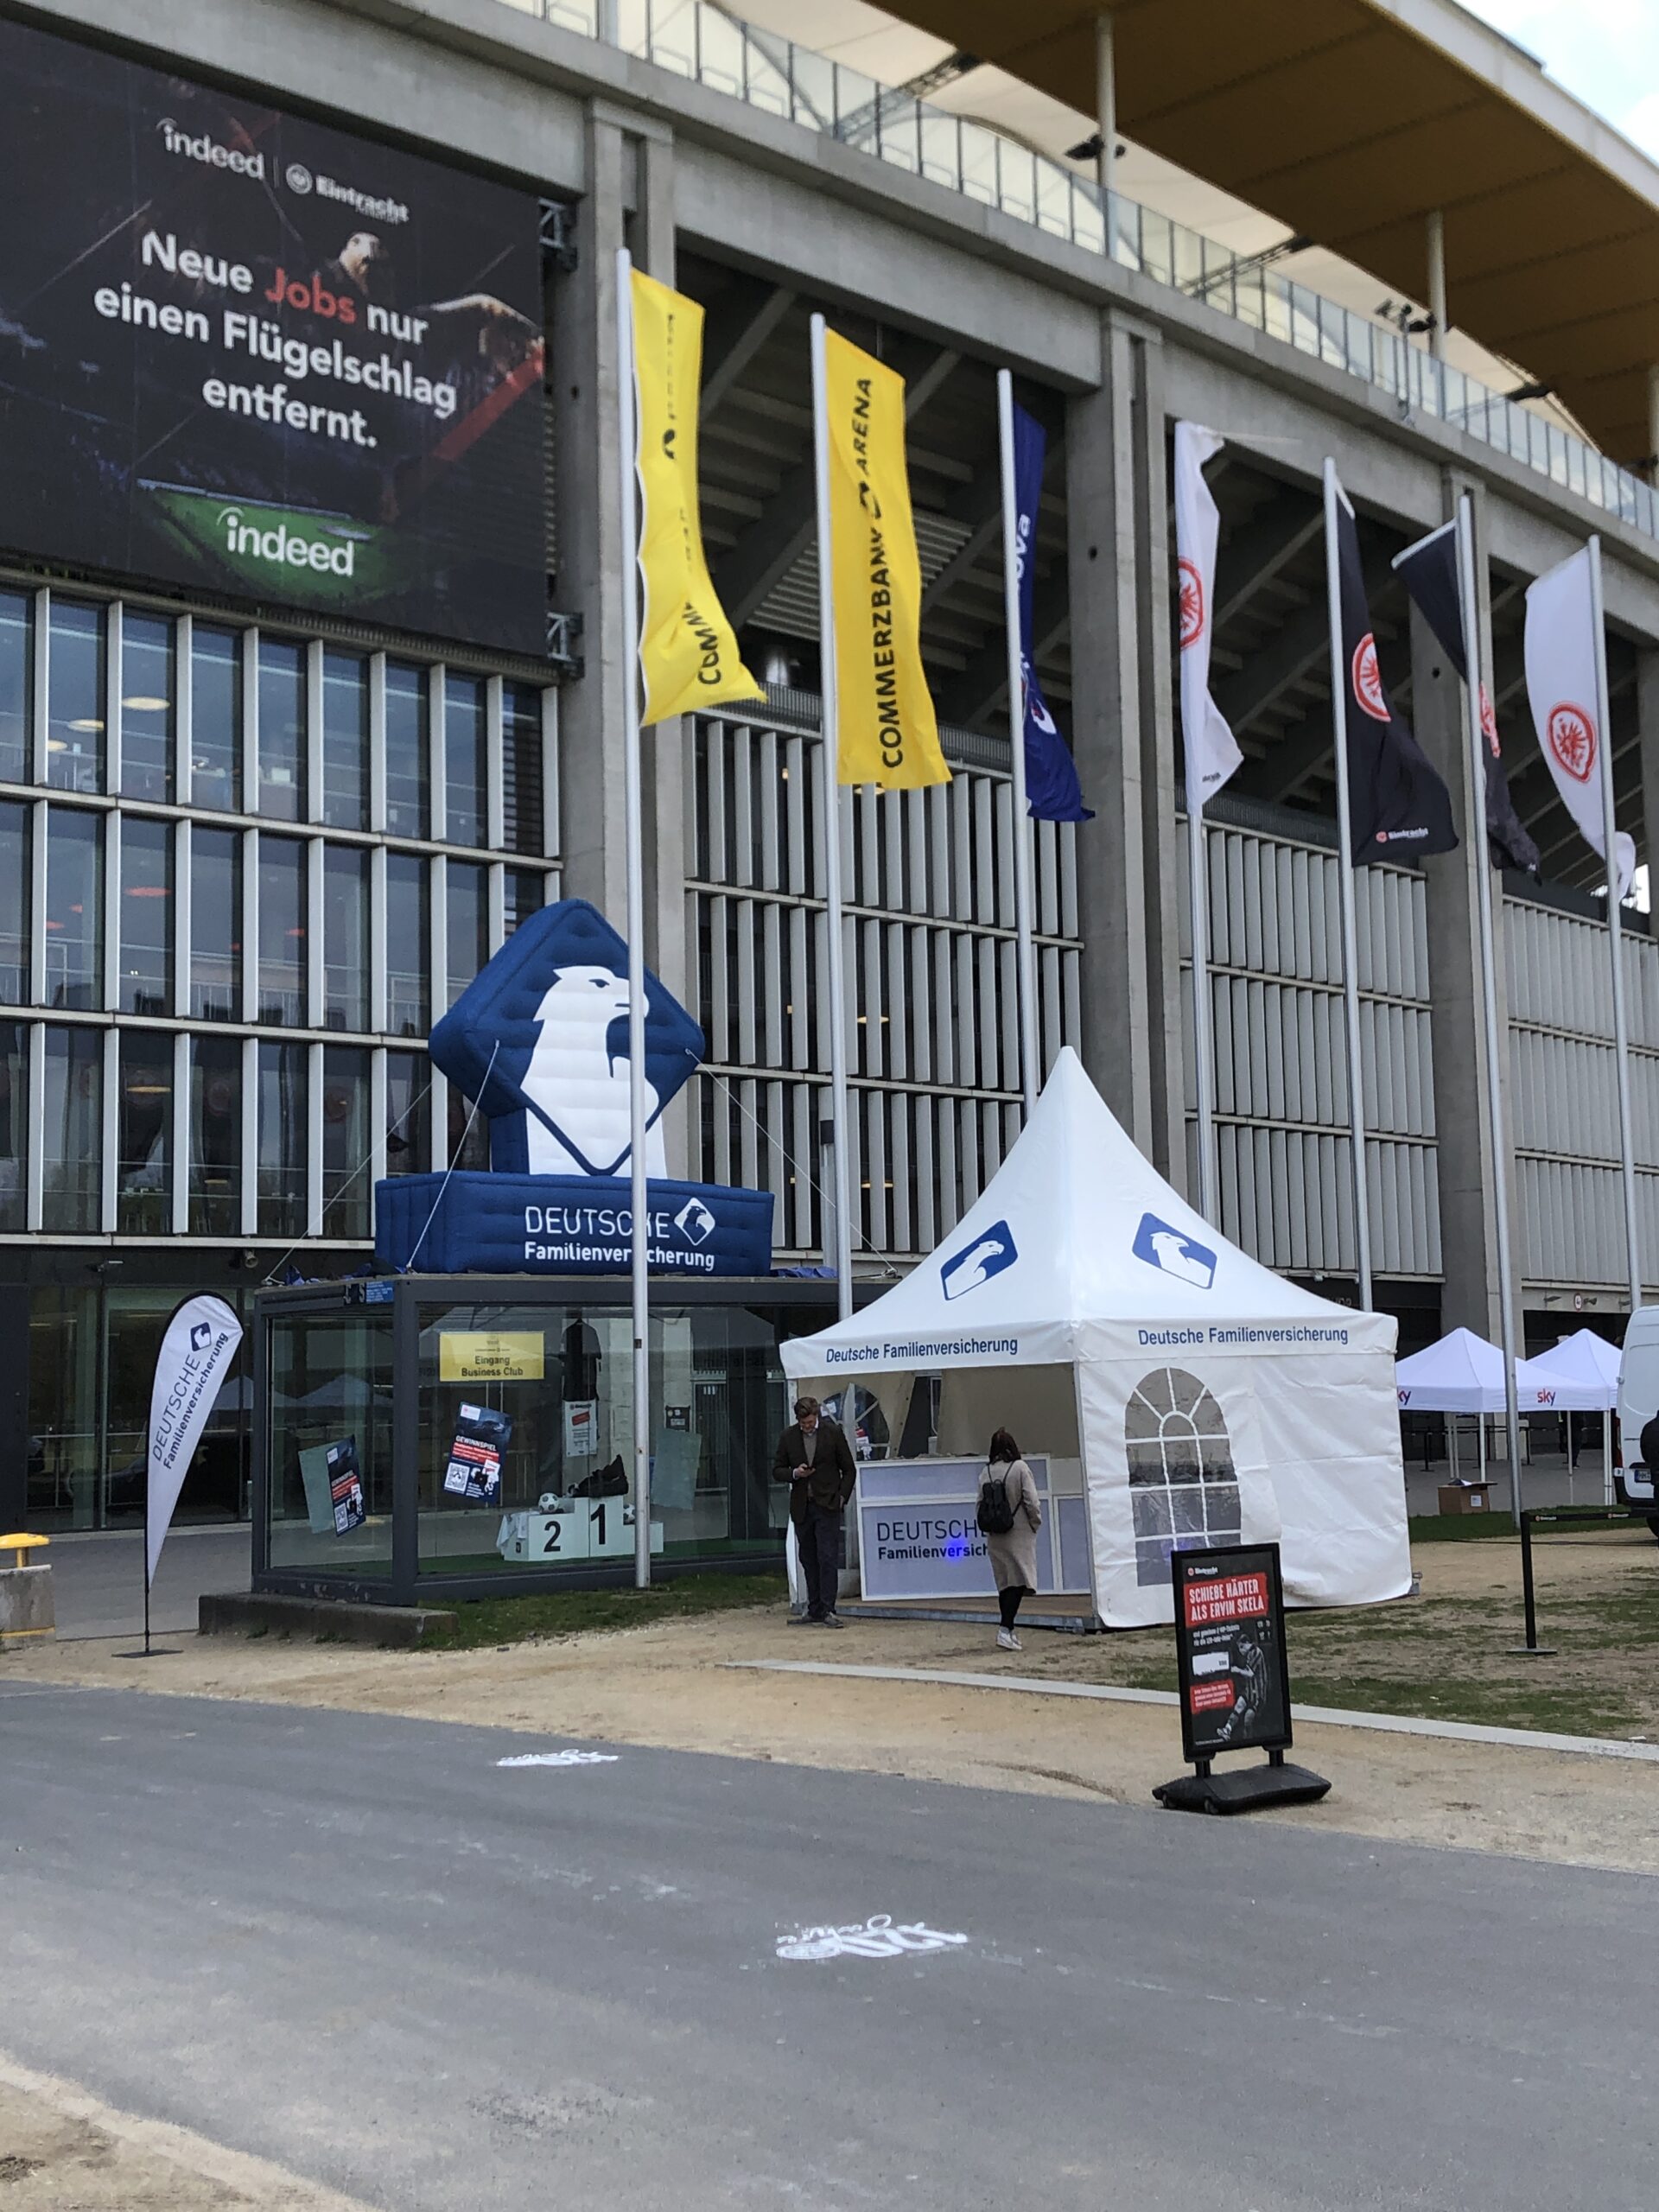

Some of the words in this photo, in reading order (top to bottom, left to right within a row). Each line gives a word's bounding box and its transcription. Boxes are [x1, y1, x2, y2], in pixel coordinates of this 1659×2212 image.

[158, 119, 264, 180] indeed
[141, 230, 253, 293] Neue
[264, 266, 357, 323] Jobs
[367, 303, 429, 345] nur
[95, 282, 209, 342] einen
[224, 309, 457, 419] Flügelschlag
[202, 378, 377, 448] entfernt.
[853, 378, 872, 477] ARENA
[217, 506, 354, 577] indeed
[524, 1241, 715, 1272] Familienvercherung
[826, 1345, 880, 1363] Deutsche
[883, 1338, 1018, 1358] Familienversicherung
[1138, 1328, 1204, 1345] Deutsche
[1209, 1326, 1348, 1344] Familienversicherung
[461, 1367, 501, 1376] Business
[504, 1367, 523, 1376] Club
[475, 1356, 510, 1366] Eingang
[153, 1354, 201, 1462] DEUTSCHE
[163, 1332, 229, 1470] Familienversicherung
[1537, 1388, 1555, 1406] sky
[543, 1521, 562, 1553] 2
[590, 1503, 606, 1545] 1
[877, 1519, 988, 1541] DEUTSCH
[1191, 1605, 1207, 1621] ALS
[1210, 1600, 1236, 1618] ERVIN
[1237, 1595, 1264, 1613] SKELA
